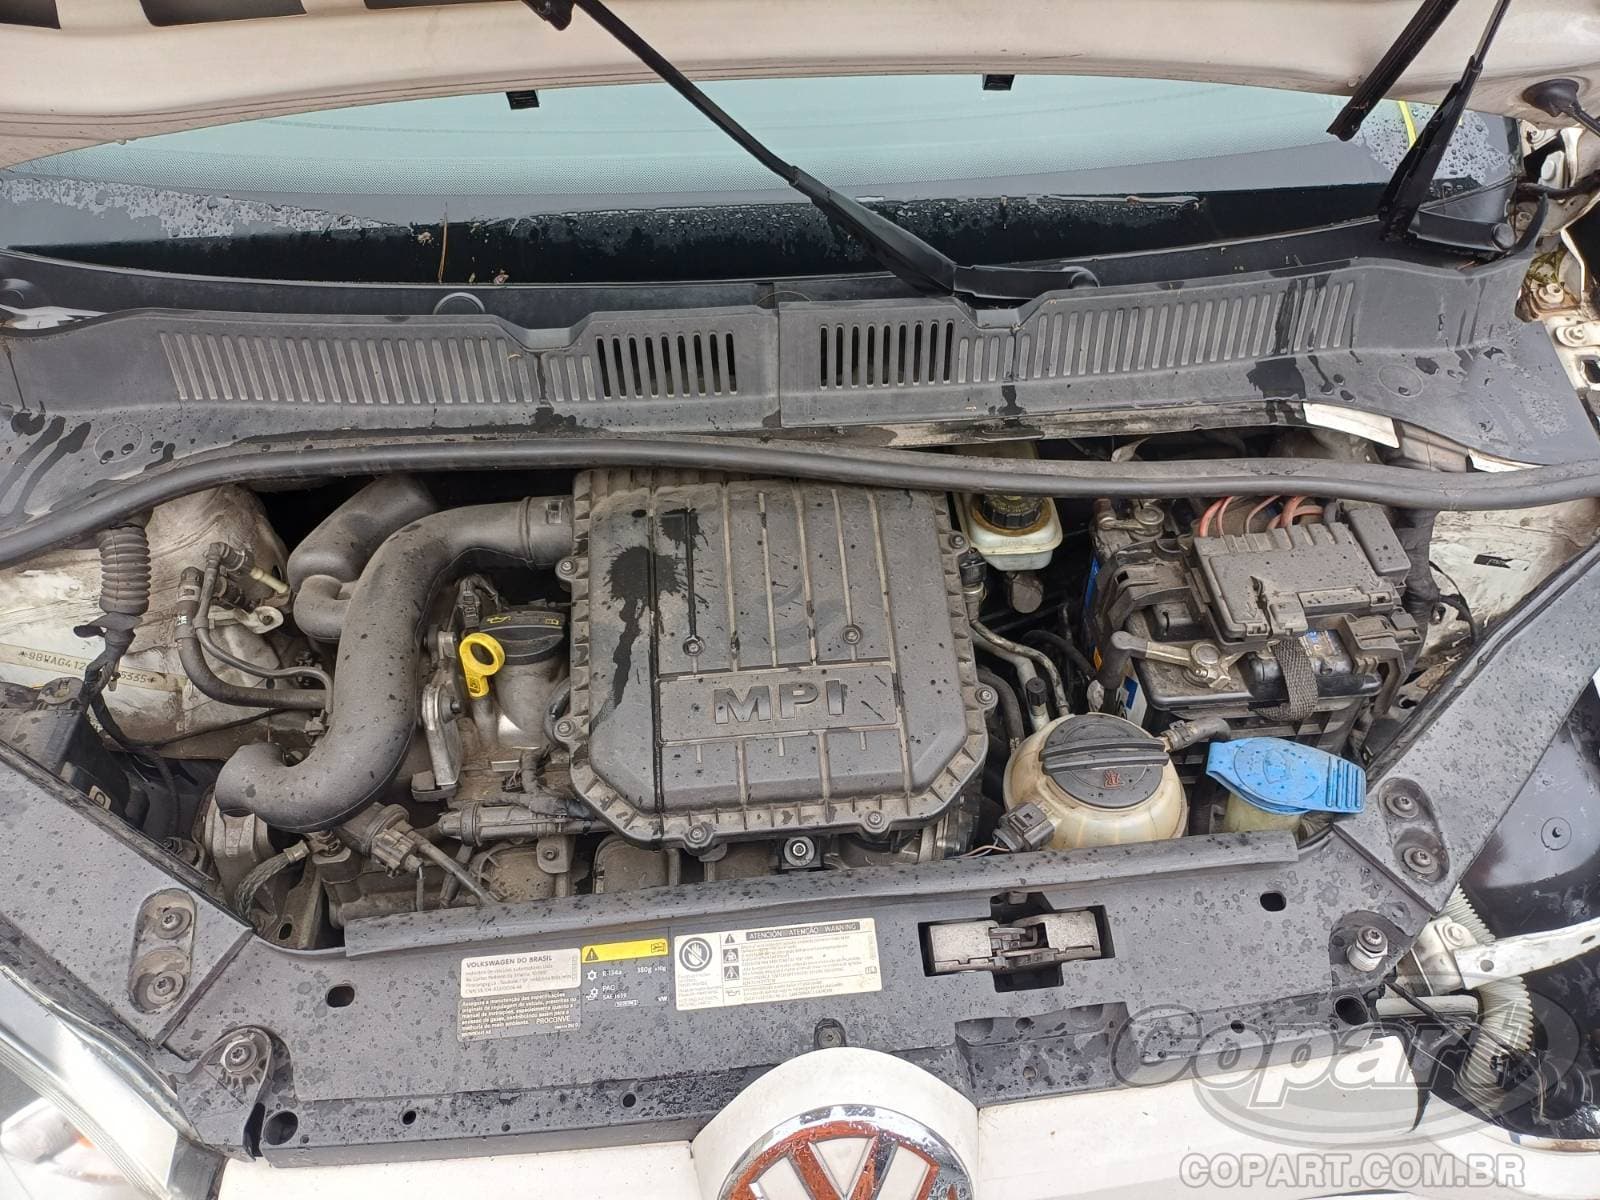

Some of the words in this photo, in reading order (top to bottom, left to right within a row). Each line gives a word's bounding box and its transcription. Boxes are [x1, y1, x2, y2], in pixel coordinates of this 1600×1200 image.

[714, 680, 844, 724] MPI
[466, 958, 515, 968] VOLKSWAGEN
[528, 955, 553, 963] BRASIL
